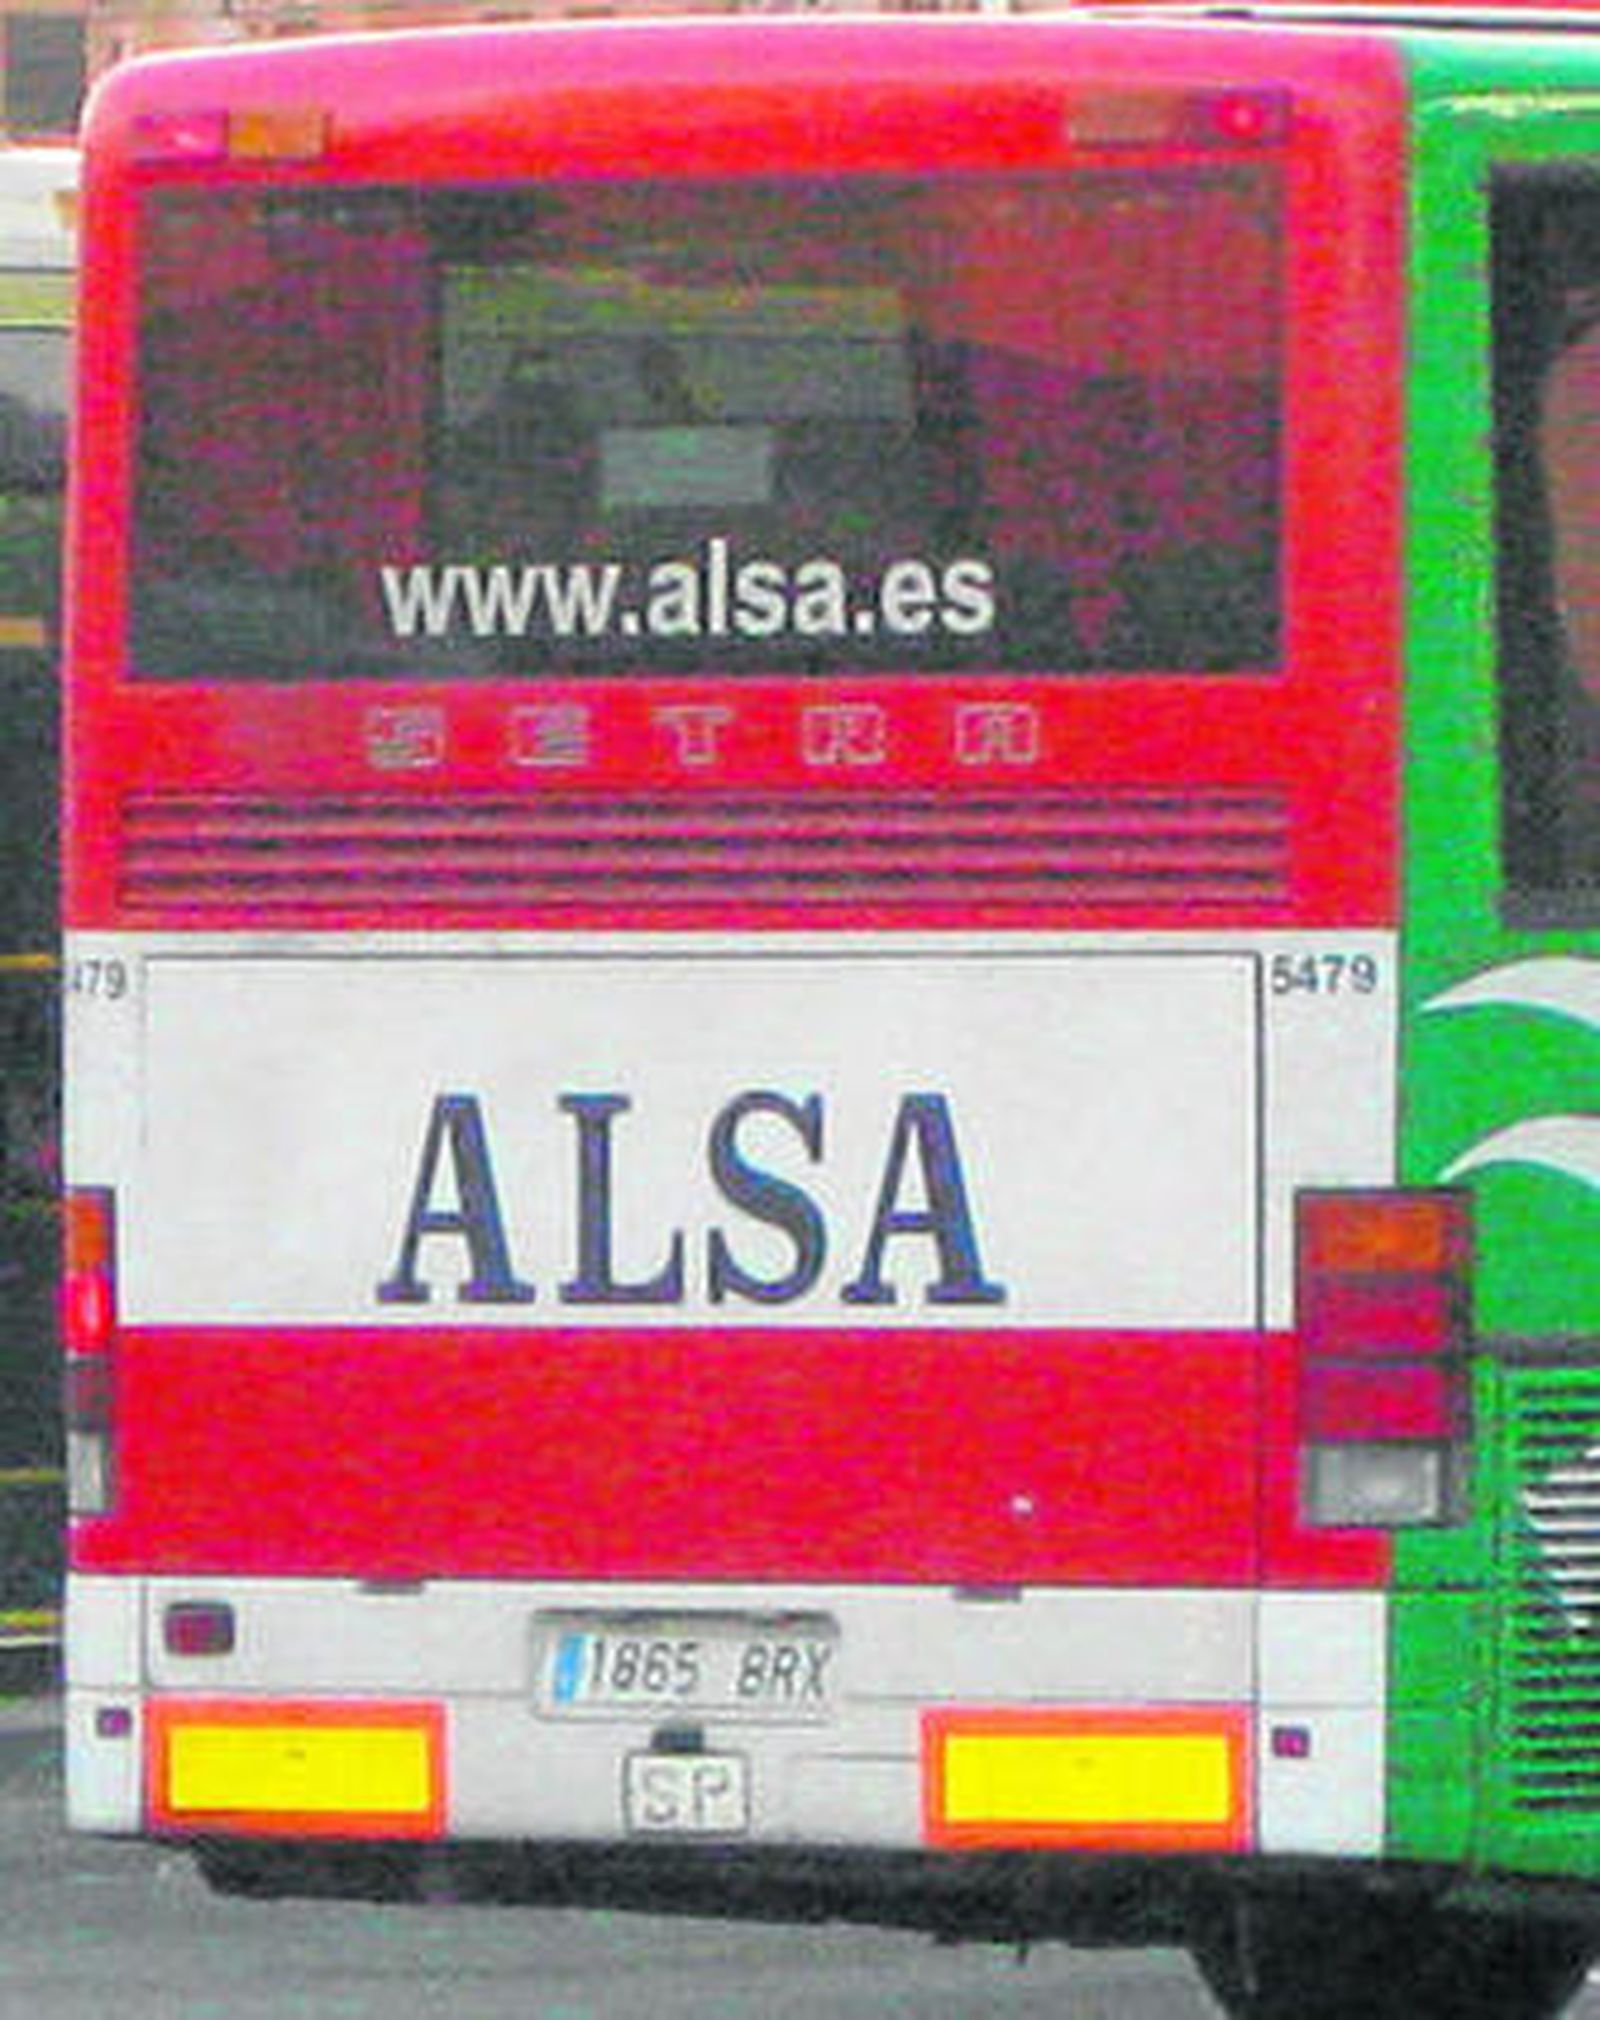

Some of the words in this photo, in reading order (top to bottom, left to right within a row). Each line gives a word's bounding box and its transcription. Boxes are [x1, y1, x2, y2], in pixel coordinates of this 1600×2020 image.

[381, 538, 996, 636] www.alsa.es
[1271, 954, 1377, 995] 5479
[375, 1089, 1006, 1305] ALSA
[591, 1637, 700, 1696] 1865
[738, 1643, 834, 1698] BRX
[642, 1763, 731, 1825] SP
